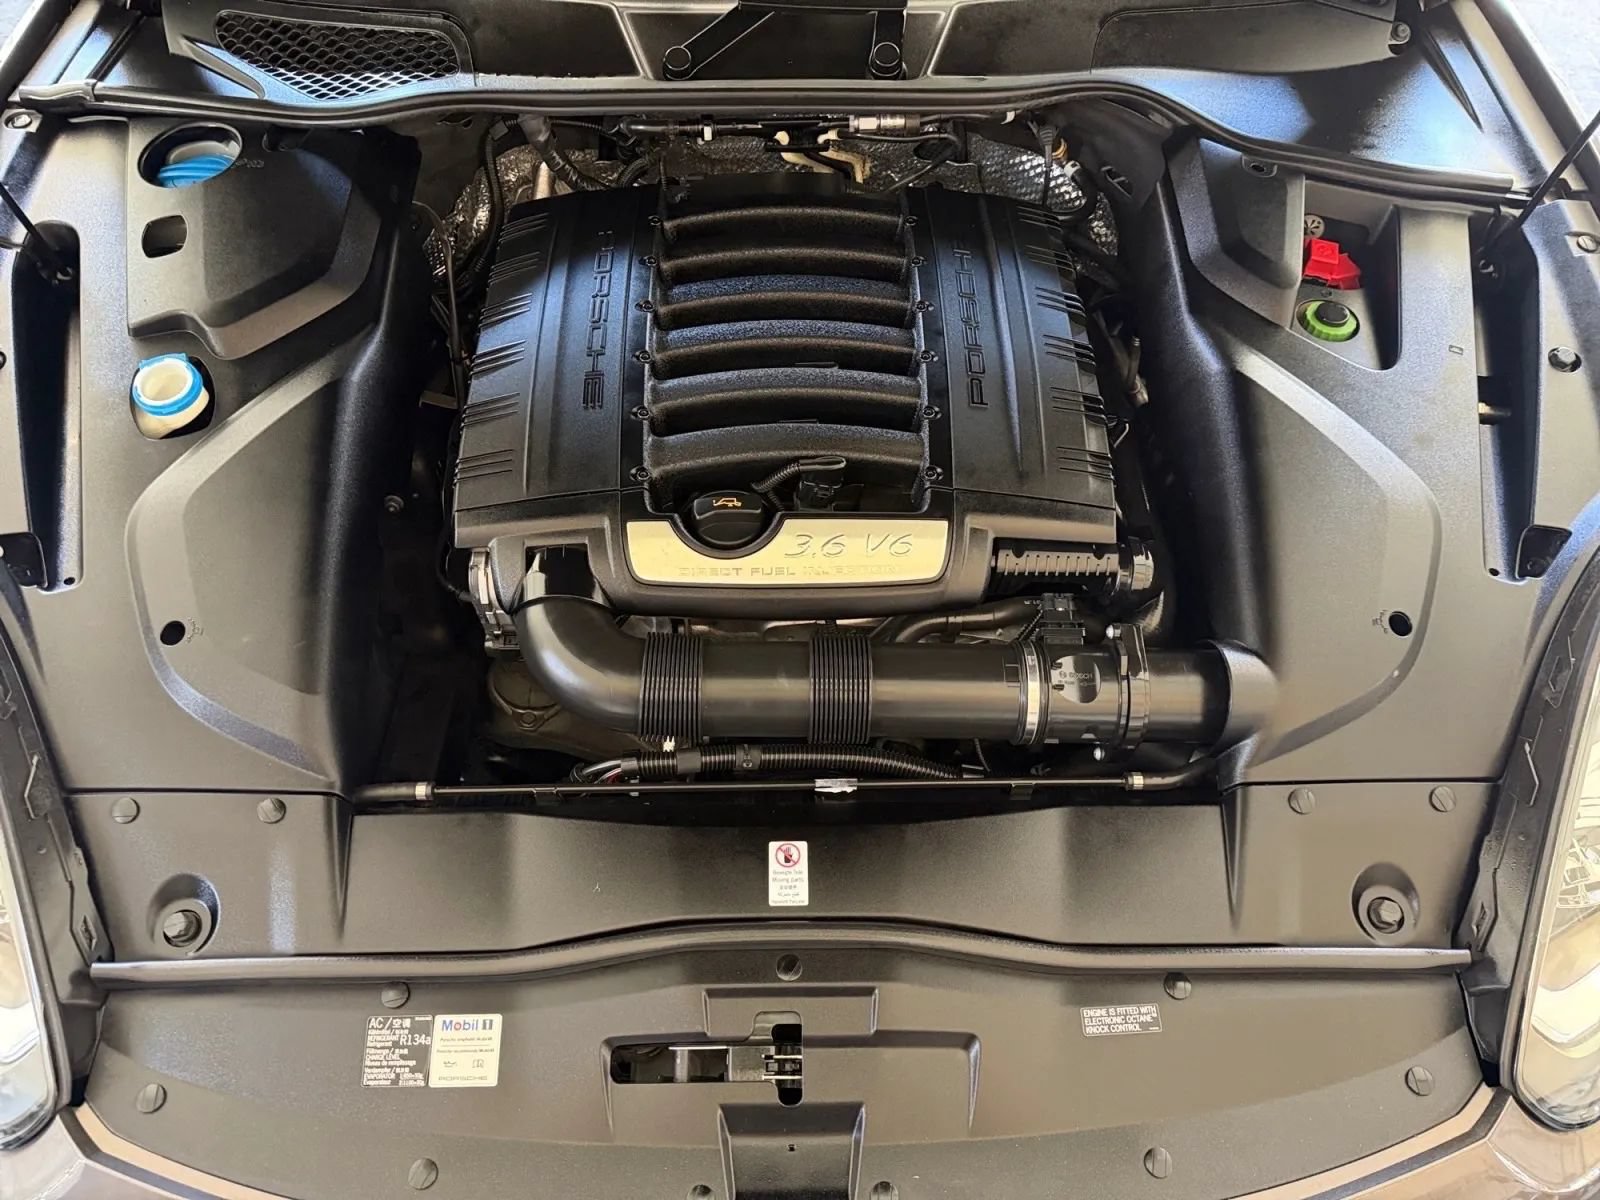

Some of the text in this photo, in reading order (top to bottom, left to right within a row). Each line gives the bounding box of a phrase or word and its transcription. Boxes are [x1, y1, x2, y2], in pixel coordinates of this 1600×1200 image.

[952, 240, 989, 407] PORSCH
[784, 533, 913, 558] 3.6 V6
[678, 567, 742, 577] DIRECT
[750, 566, 796, 576] FUEL
[1083, 1005, 1156, 1017] ENGINE IS FITTED WITH
[369, 1017, 384, 1029] AC
[442, 1018, 479, 1031] Mobil
[1084, 1016, 1125, 1025] ELECTRONIC
[1086, 1024, 1142, 1034] KNOCK CONTROL
[400, 1034, 432, 1046] R134a
